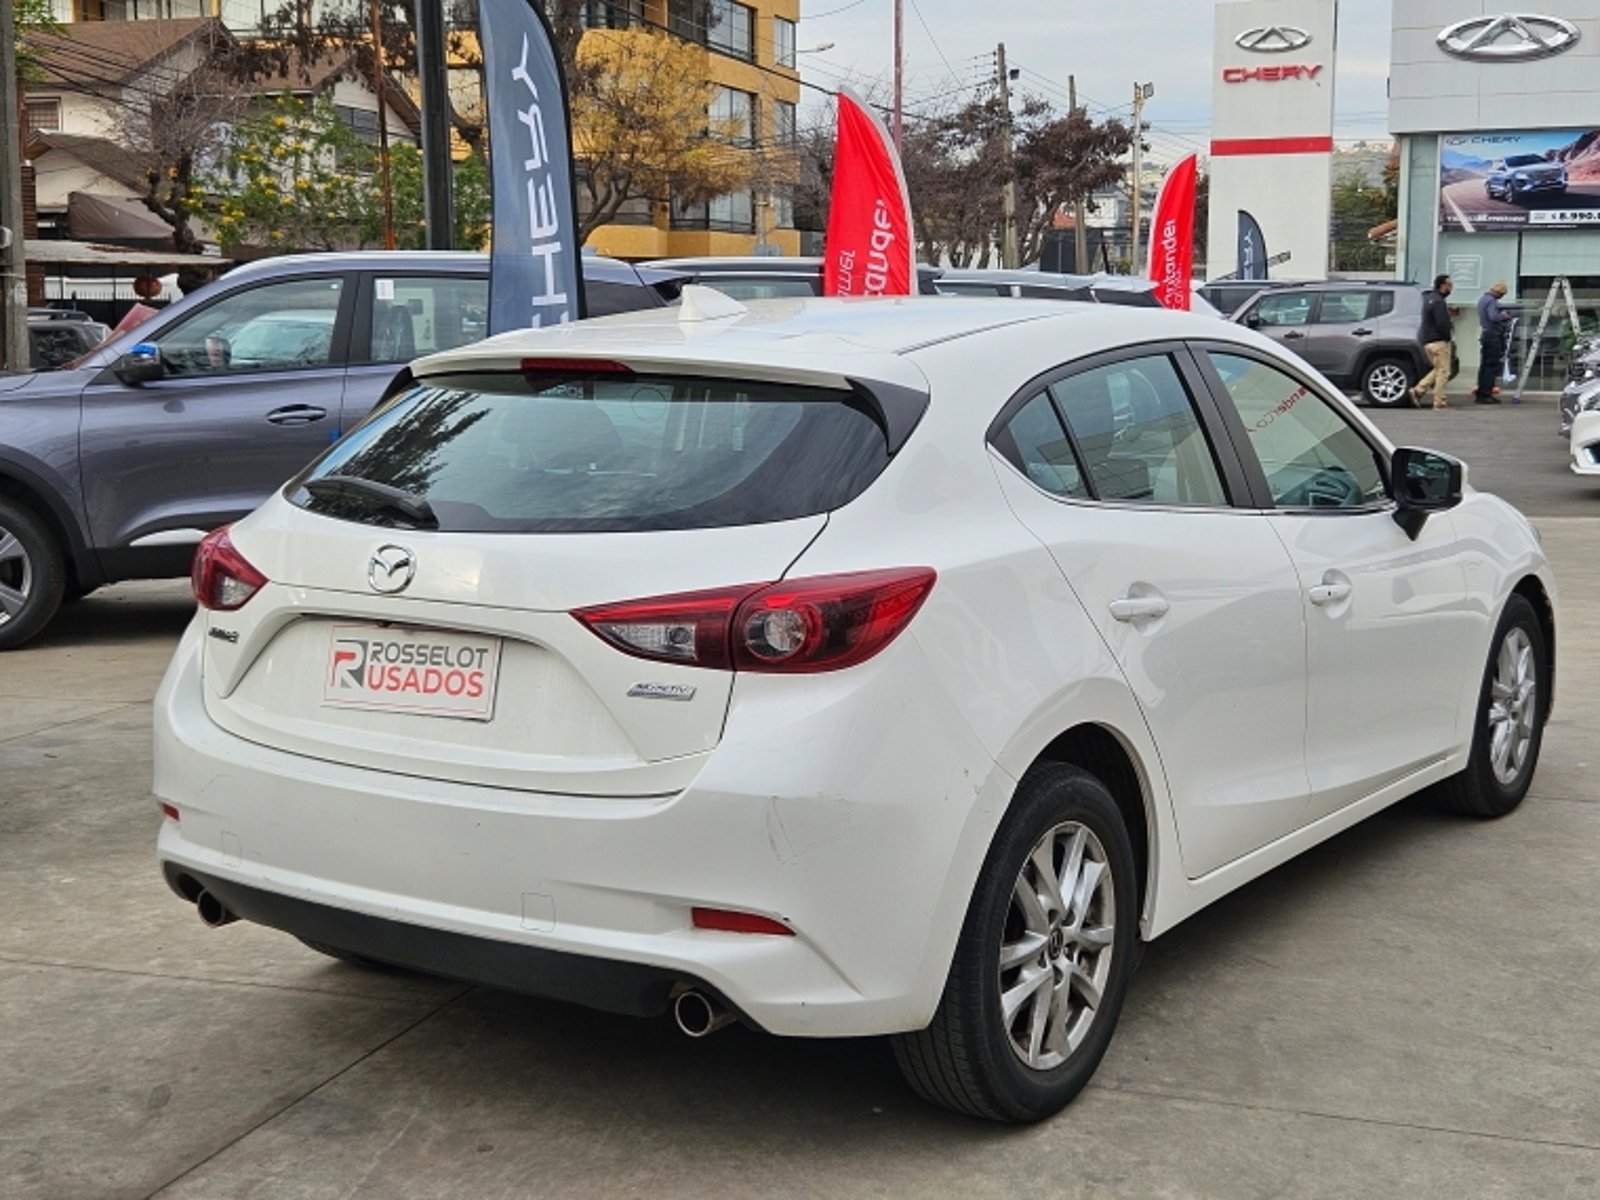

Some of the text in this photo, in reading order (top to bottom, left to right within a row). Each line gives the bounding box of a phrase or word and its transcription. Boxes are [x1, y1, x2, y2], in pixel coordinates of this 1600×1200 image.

[1222, 64, 1323, 83] CHERY
[1471, 136, 1521, 144] CHERY
[1558, 211, 1600, 221] 8.990.
[1161, 219, 1177, 309] antander
[370, 641, 489, 668] ROSSELOT
[367, 665, 484, 698] USADOS
